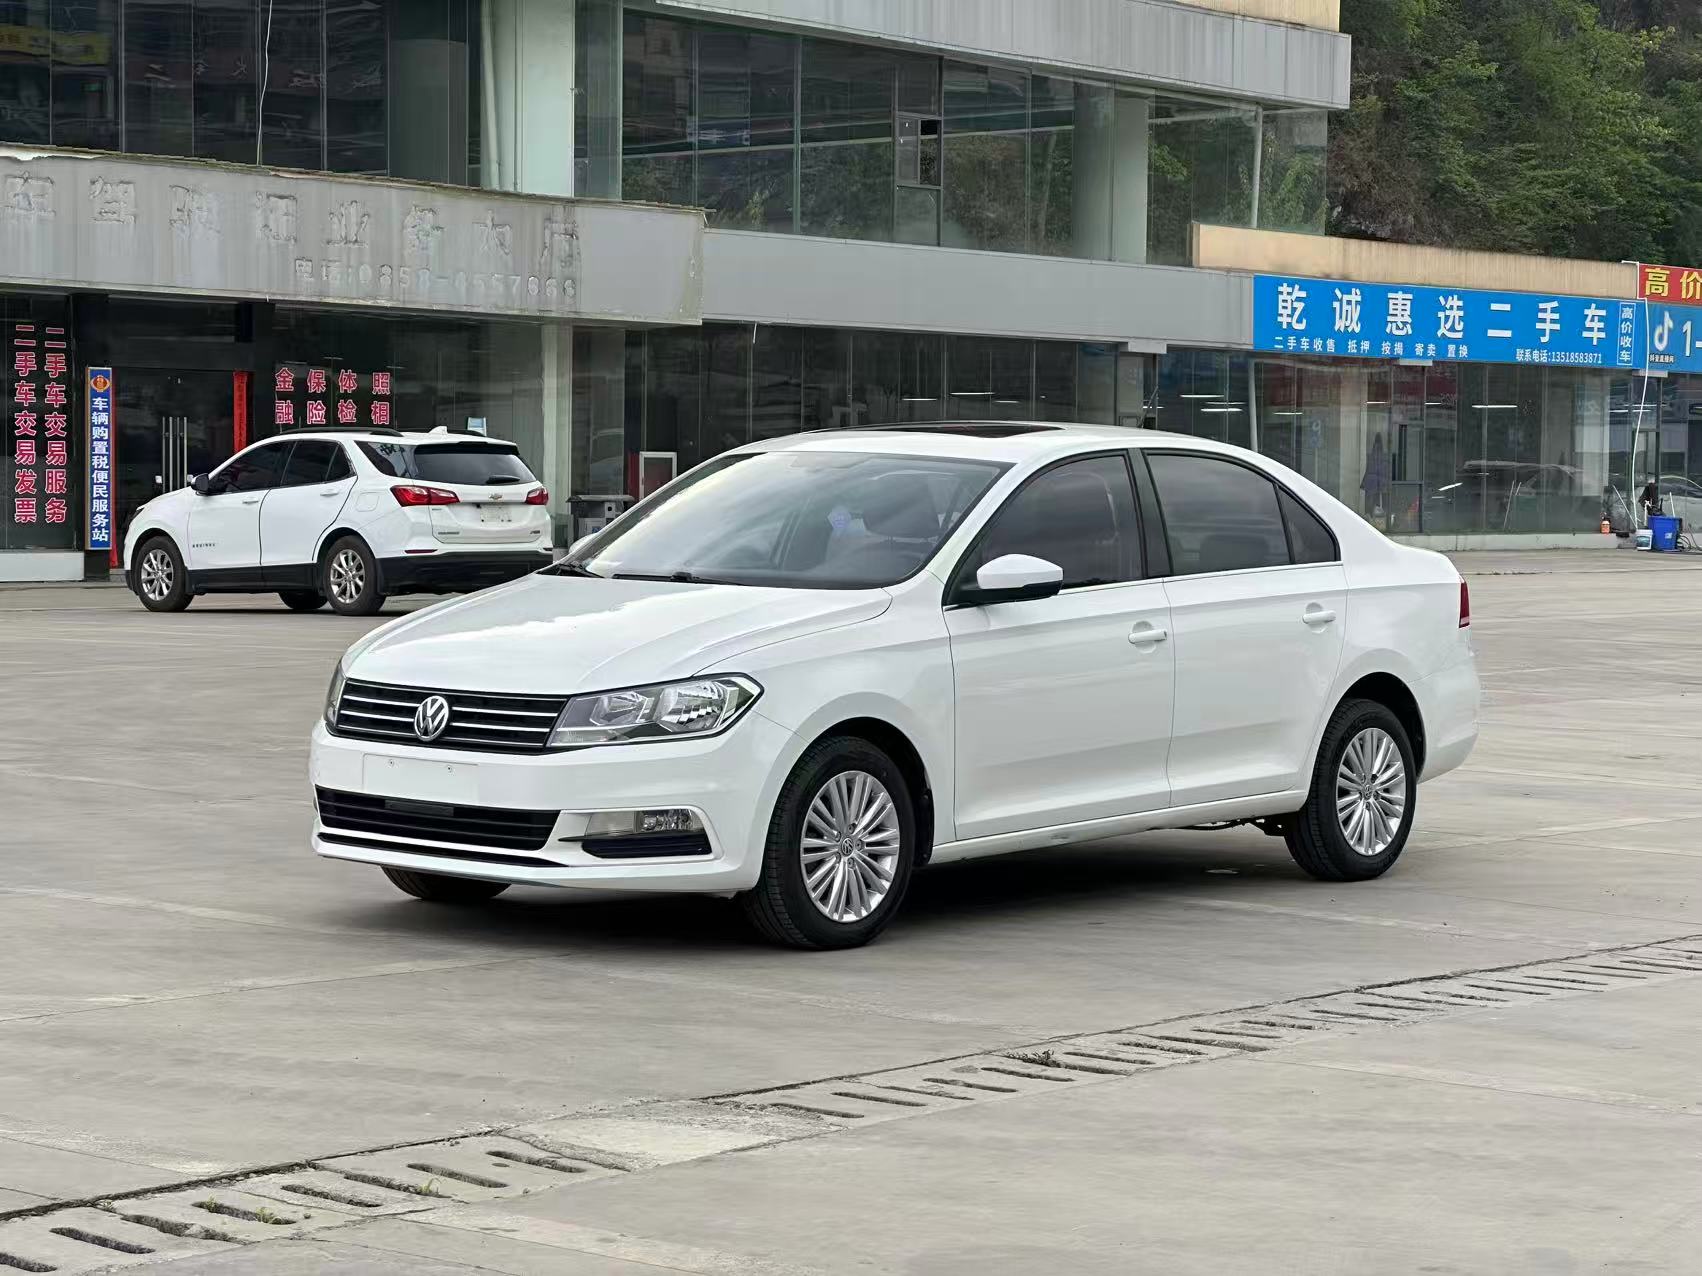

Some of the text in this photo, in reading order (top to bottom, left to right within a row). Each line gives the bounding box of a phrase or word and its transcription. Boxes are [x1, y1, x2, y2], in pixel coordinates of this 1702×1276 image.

[1277, 283, 1606, 345] 乾诚惠选二手车
[1619, 307, 1634, 362] 高价收车
[1274, 336, 1468, 358] 二手车收售 抵押 按揭 寄卖 置换
[14, 325, 37, 523] 二手车交易发票
[275, 368, 294, 425] 金融
[307, 369, 327, 425] 保险
[338, 369, 357, 424] 体检
[371, 372, 390, 425] 照相
[44, 327, 67, 524] 二手车交易服务
[91, 397, 110, 542] 车辆购置税便民服务站
